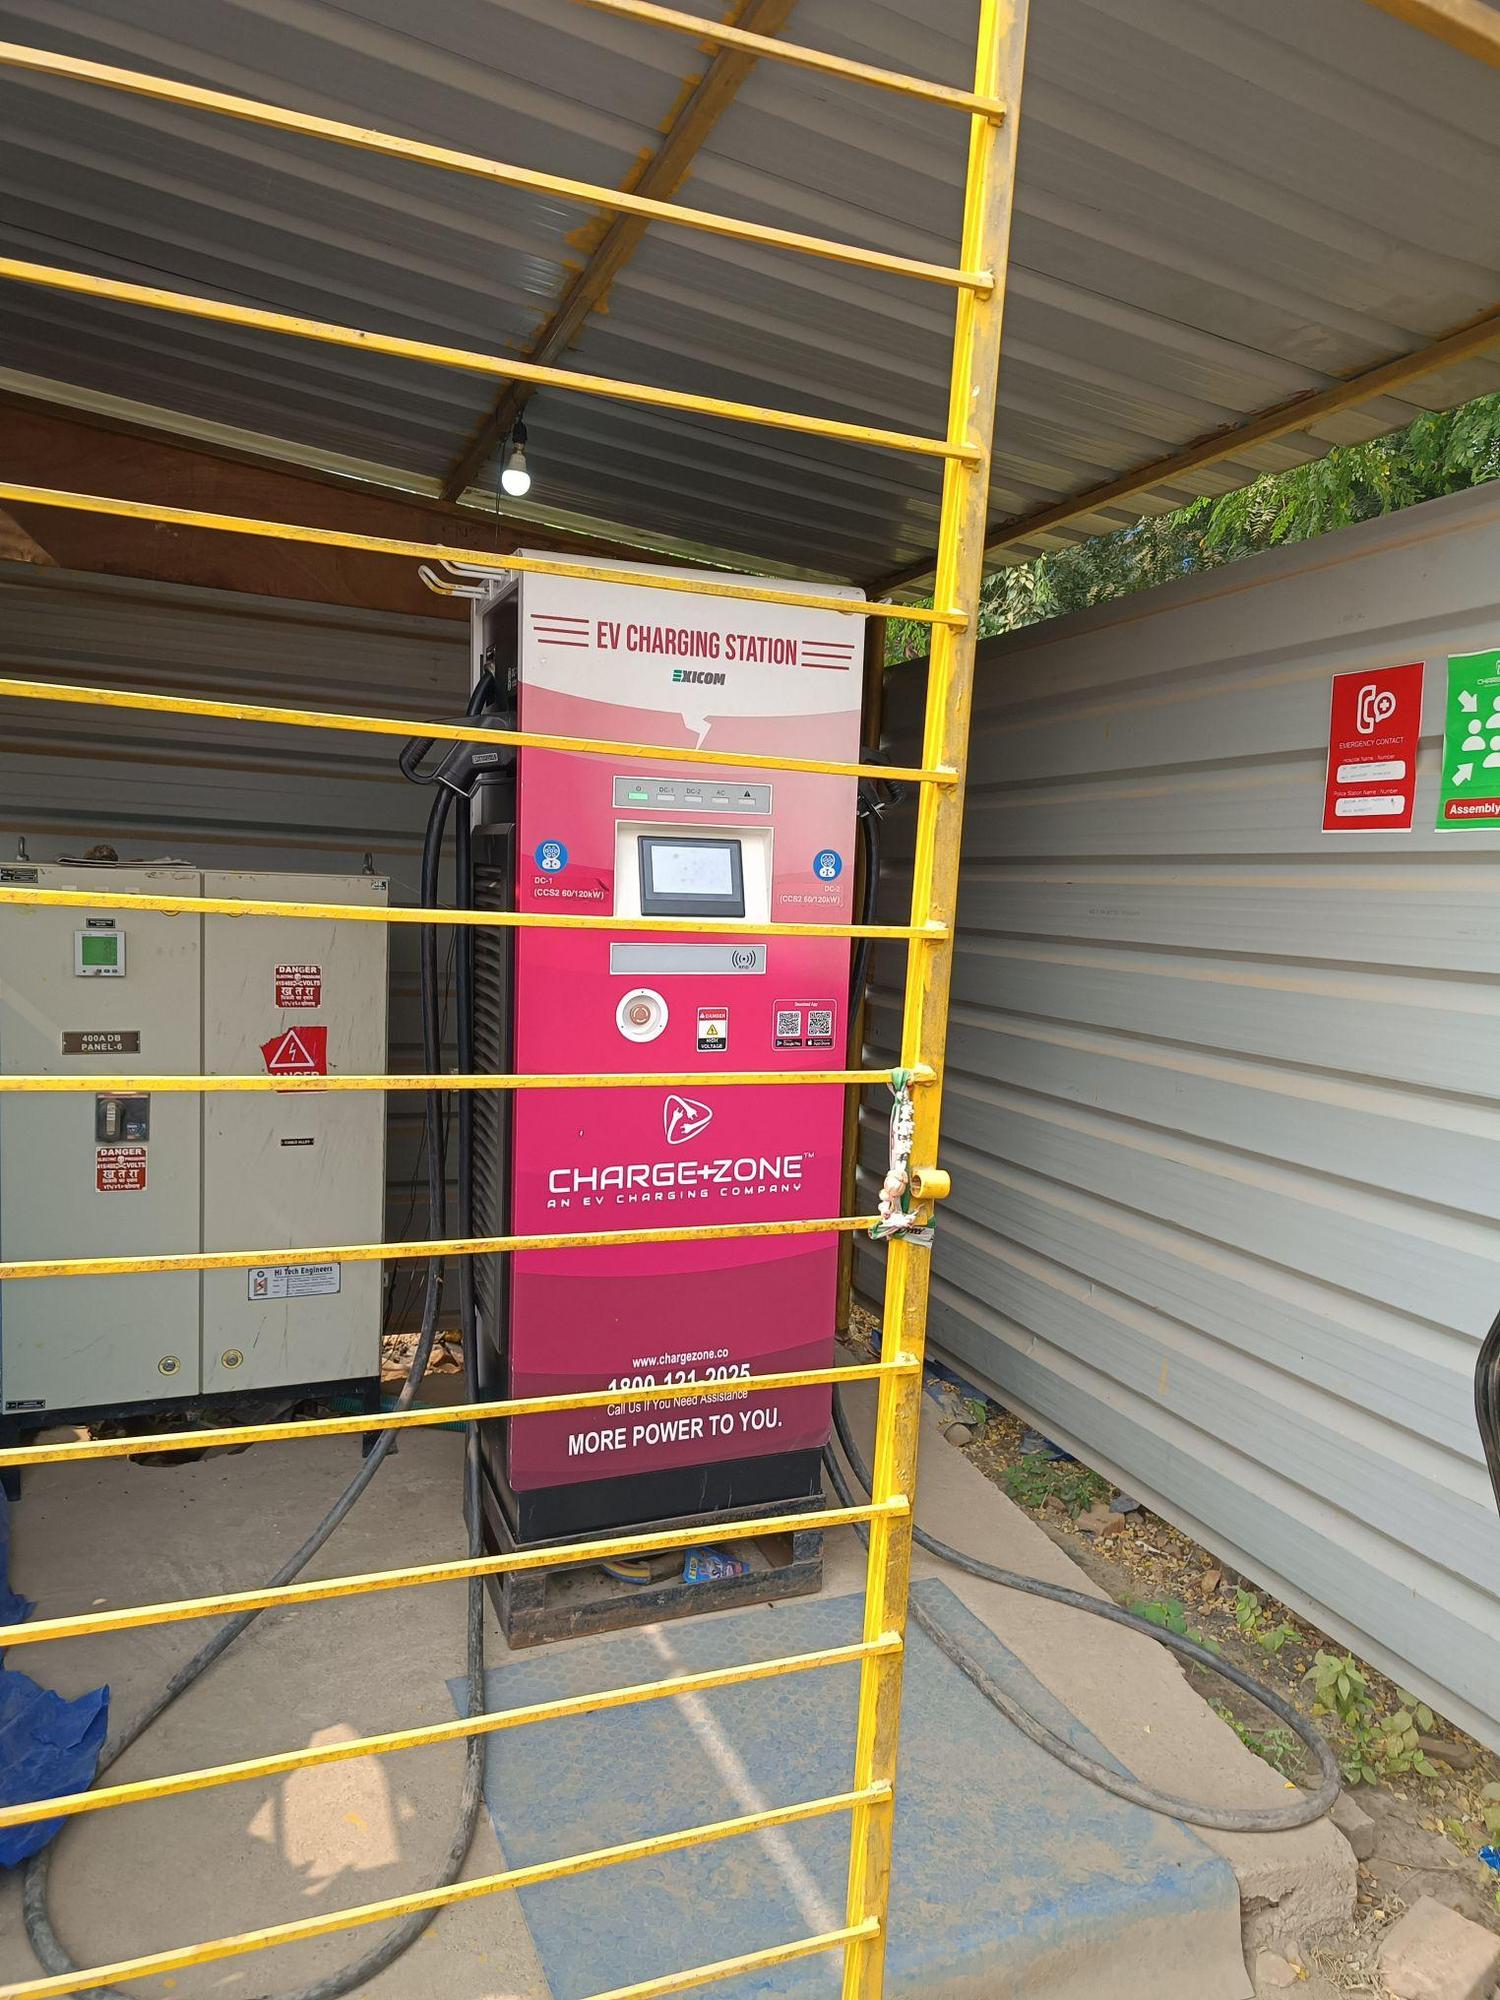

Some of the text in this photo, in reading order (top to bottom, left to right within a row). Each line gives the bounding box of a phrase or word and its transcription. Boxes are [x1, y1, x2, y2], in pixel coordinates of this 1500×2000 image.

[597, 621, 798, 666] EV CHARGING STATION
[672, 669, 726, 686] EXICOM
[1339, 736, 1404, 749] EMERGENCY CONTACT
[1450, 802, 1500, 815] Assembly
[534, 876, 552, 884] DC-1
[534, 888, 604, 900] (CCS2 60/120kW)
[824, 885, 840, 893] DC-2
[279, 966, 317, 974] DANGER
[82, 1034, 121, 1042] 400A DB
[81, 1043, 123, 1051] PANEL-6
[101, 1148, 142, 1156] DANGER
[549, 1155, 803, 1194] CHARGE+ZONE
[547, 1183, 802, 1208] AN EV CHARGING COMPANY
[301, 1266, 333, 1275] Engineers
[632, 1348, 729, 1368] www.chargezone.co
[607, 1390, 748, 1416] Call Us If You Need Assistance
[568, 1407, 782, 1456] MORE POWER TO YOU.
